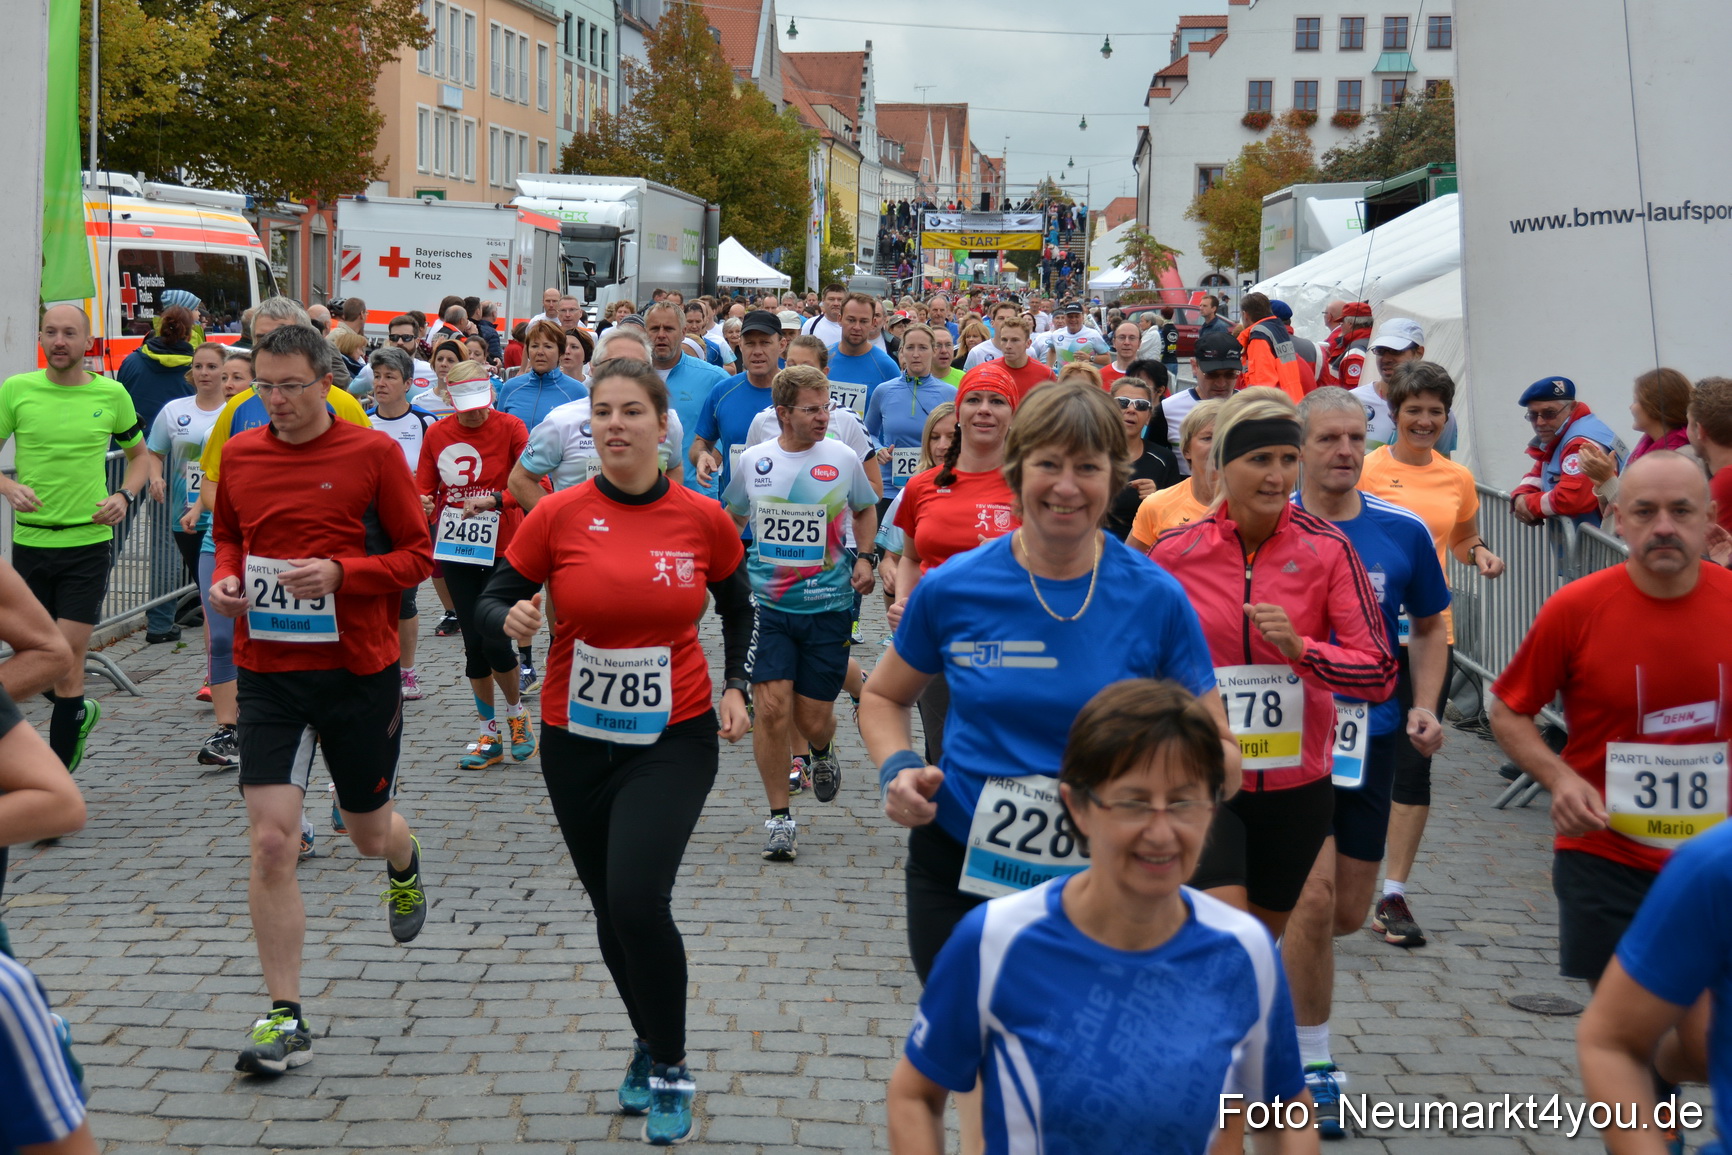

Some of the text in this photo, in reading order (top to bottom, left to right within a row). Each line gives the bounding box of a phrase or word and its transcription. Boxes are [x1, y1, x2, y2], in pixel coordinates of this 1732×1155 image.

[537, 209, 588, 223] OCK
[960, 236, 1002, 247] START
[415, 247, 473, 259] Bayerisches
[415, 260, 442, 269] Rotes
[137, 273, 165, 289] Bayerisches
[414, 271, 442, 281] Kreuz
[721, 275, 759, 285] Laufsport
[139, 289, 153, 303] Rotes
[454, 456, 477, 482] 3
[758, 507, 814, 517] PARTL Neumarkt
[443, 520, 493, 544] 2485
[588, 524, 610, 532] erima
[763, 517, 820, 543] 2525
[455, 546, 475, 556] Heidi
[775, 546, 805, 558] Rudolf
[247, 564, 272, 575] PARTL
[271, 616, 311, 631] Roland
[576, 648, 654, 667] PARTL Neumarkt
[577, 667, 663, 707] 2785
[1228, 675, 1282, 687] Neumarkt
[596, 713, 637, 731] Franzi
[1662, 710, 1696, 725] DEHN
[1610, 753, 1709, 766] PARTL Neumarkt
[988, 775, 1031, 798] PARTL
[1633, 770, 1708, 810] 318
[1647, 819, 1694, 836] Mario
